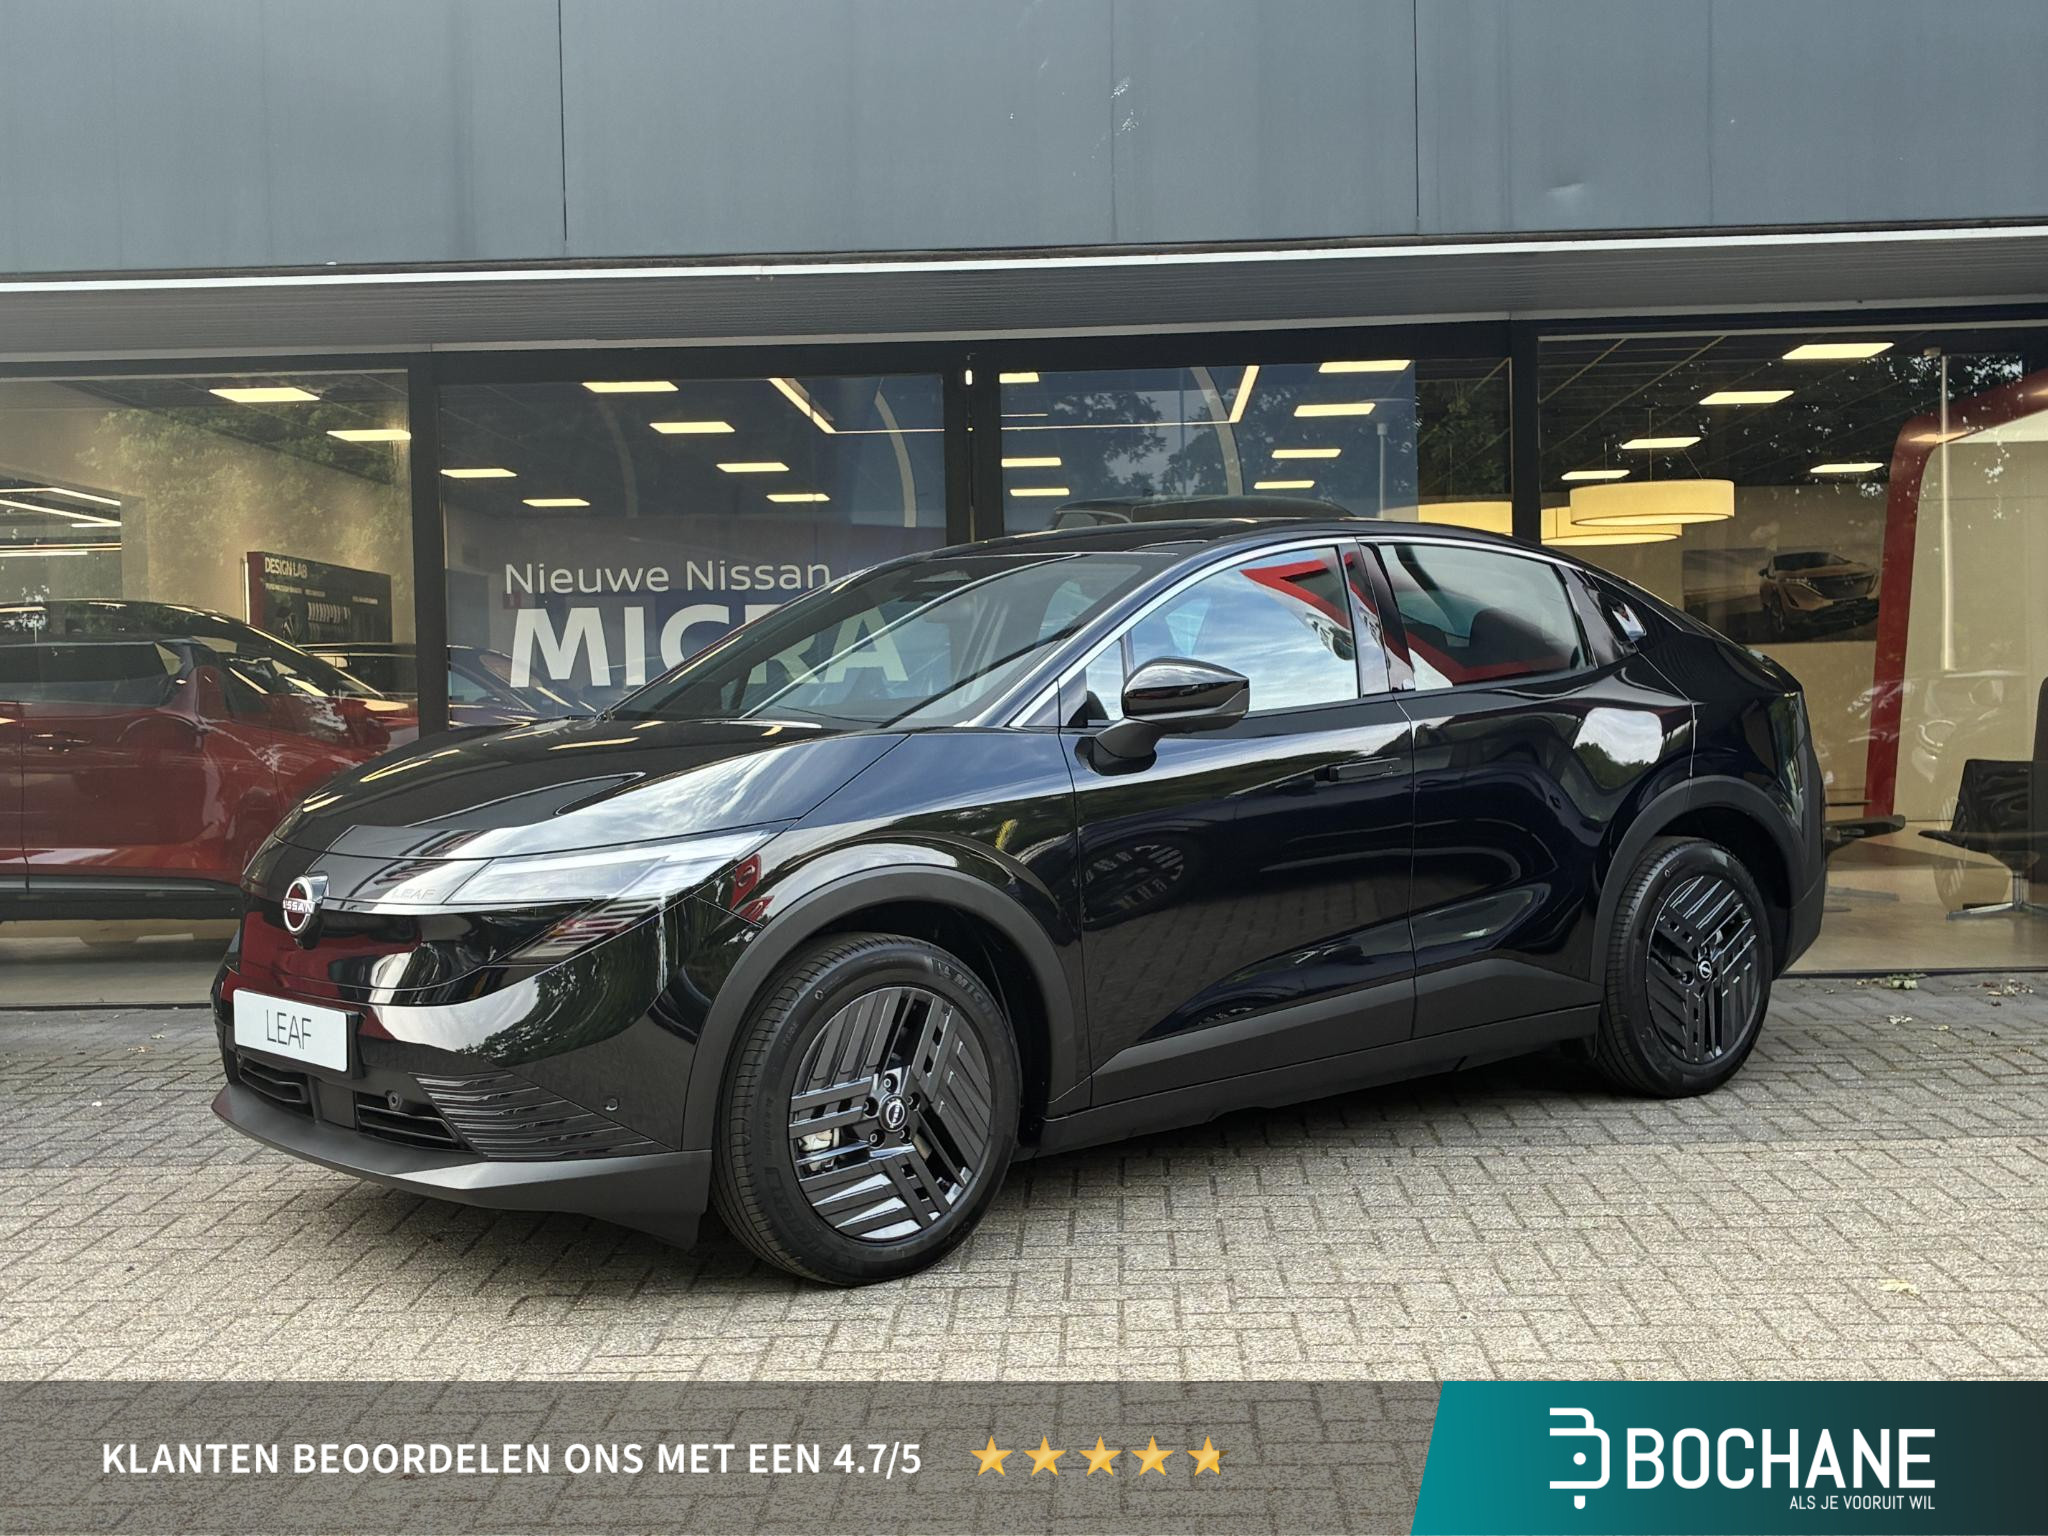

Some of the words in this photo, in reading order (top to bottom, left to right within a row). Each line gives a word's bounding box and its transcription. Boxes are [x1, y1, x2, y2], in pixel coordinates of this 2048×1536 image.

[264, 556, 292, 576] DESIGN
[292, 560, 308, 579] LAB
[505, 563, 670, 595] Nieuwe
[686, 559, 830, 592] Nissan
[266, 1008, 312, 1050] LEAF
